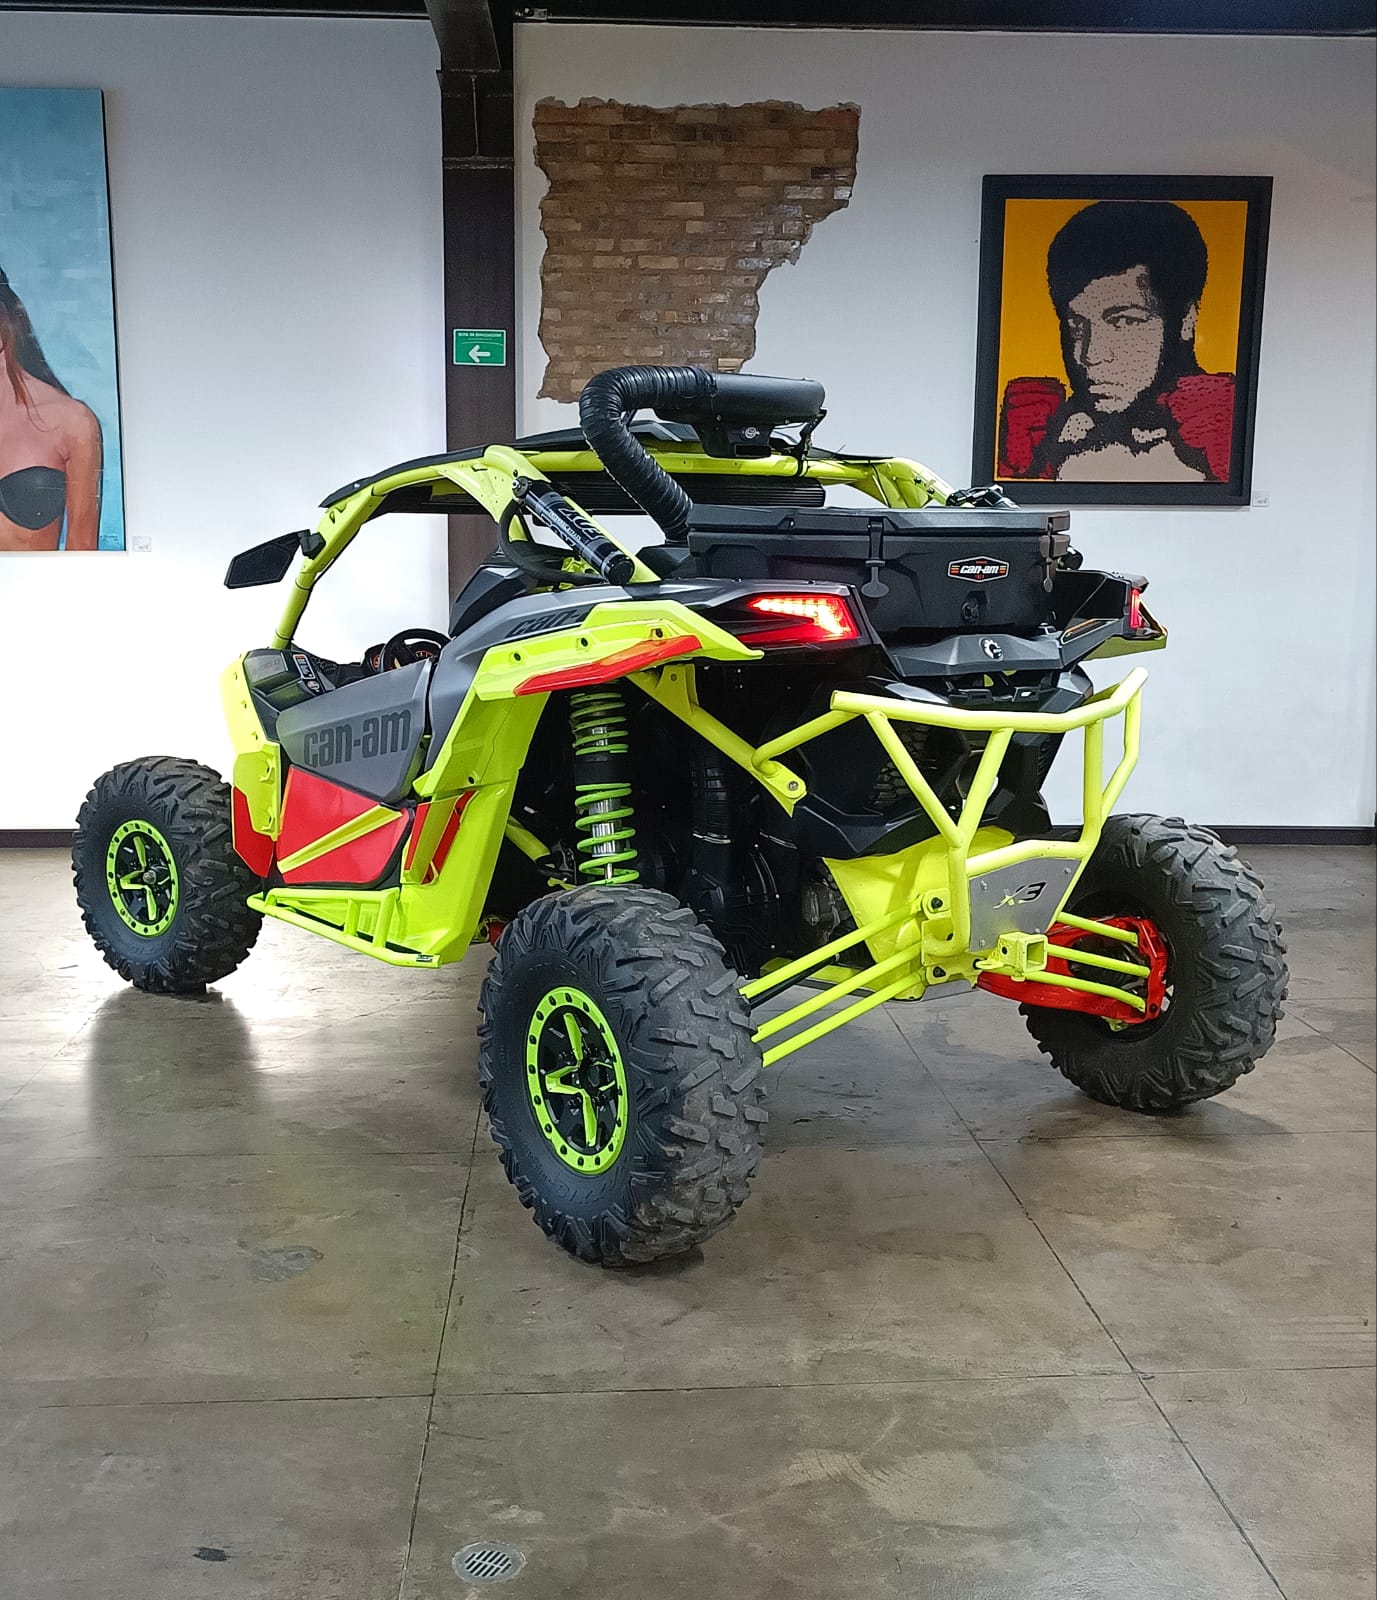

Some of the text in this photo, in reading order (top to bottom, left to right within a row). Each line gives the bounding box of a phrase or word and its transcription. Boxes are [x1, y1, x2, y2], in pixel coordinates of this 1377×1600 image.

[960, 565, 1000, 574] can-am
[303, 709, 411, 768] can-am
[992, 881, 1048, 909] X3
